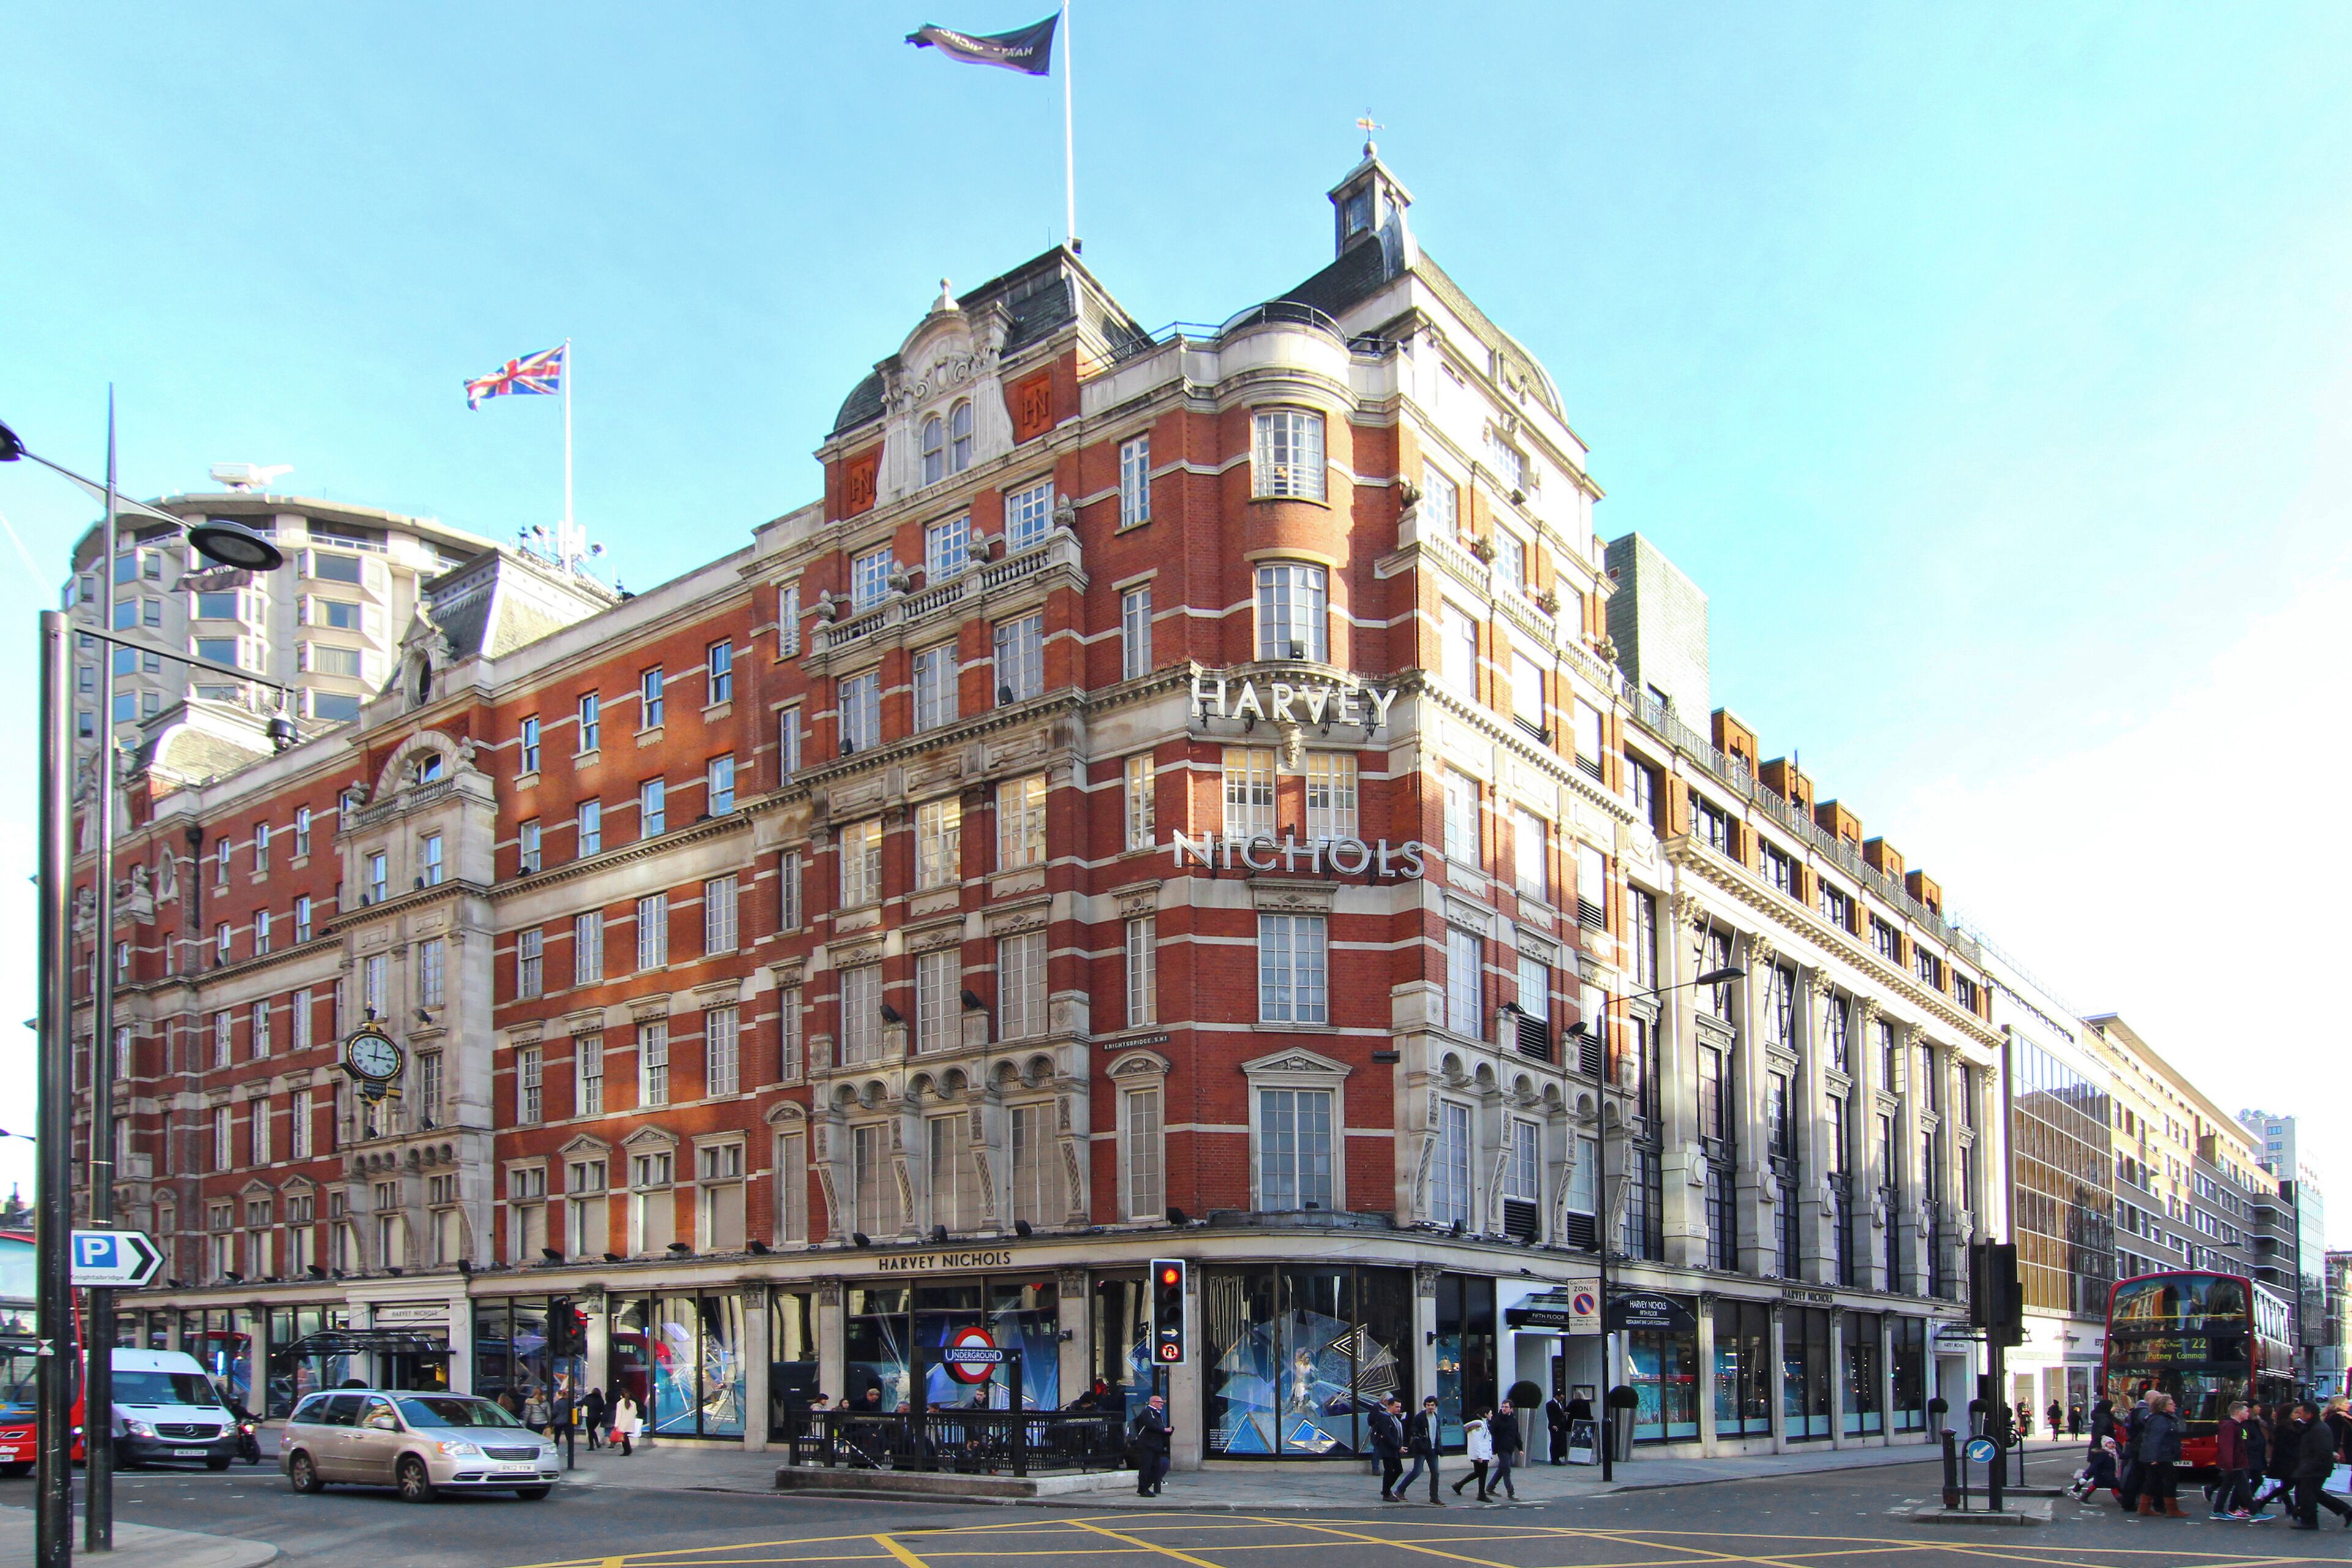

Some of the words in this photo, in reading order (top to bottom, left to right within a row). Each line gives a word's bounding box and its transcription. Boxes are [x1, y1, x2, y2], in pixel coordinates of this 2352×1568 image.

[1191, 678, 1397, 728] HARVEY
[1173, 828, 1425, 879] NICHOLS
[82, 1238, 110, 1265] P
[879, 1256, 935, 1270] HARVEY
[942, 1251, 1011, 1267] NICHOLS
[1782, 1289, 1806, 1300] HARVEY
[1807, 1291, 1833, 1303] NICHOLS
[1629, 1300, 1647, 1309] HARVEY
[1648, 1301, 1667, 1310] NICHOLS
[2192, 1338, 2206, 1348] 22
[944, 1349, 1003, 1362] UNDERGROUND
[2148, 1352, 2172, 1362] Putney
